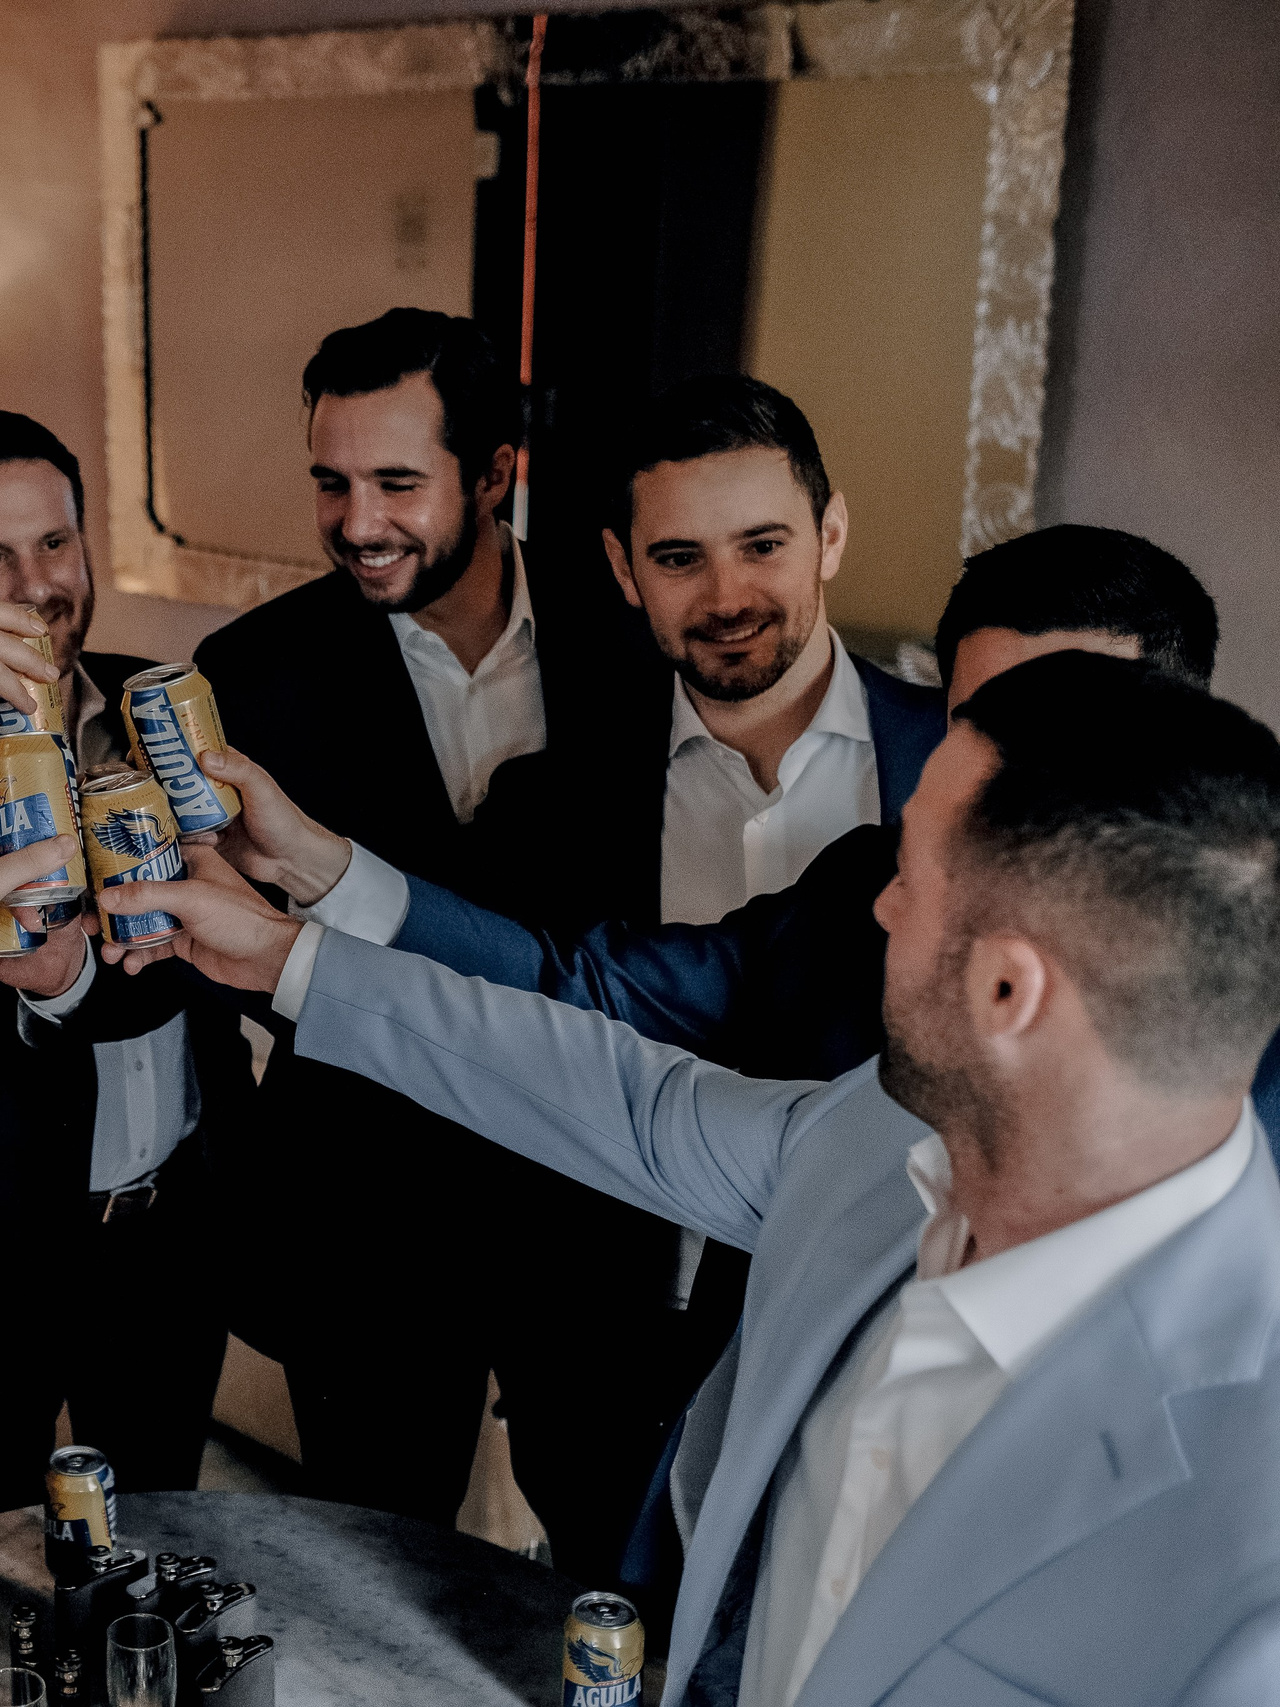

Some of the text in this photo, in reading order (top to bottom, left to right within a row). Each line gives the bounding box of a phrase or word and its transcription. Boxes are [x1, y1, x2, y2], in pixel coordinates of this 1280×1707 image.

[131, 692, 220, 818] AGUILA
[122, 838, 183, 885] GUIL
[572, 1672, 642, 1707] AGUILA
